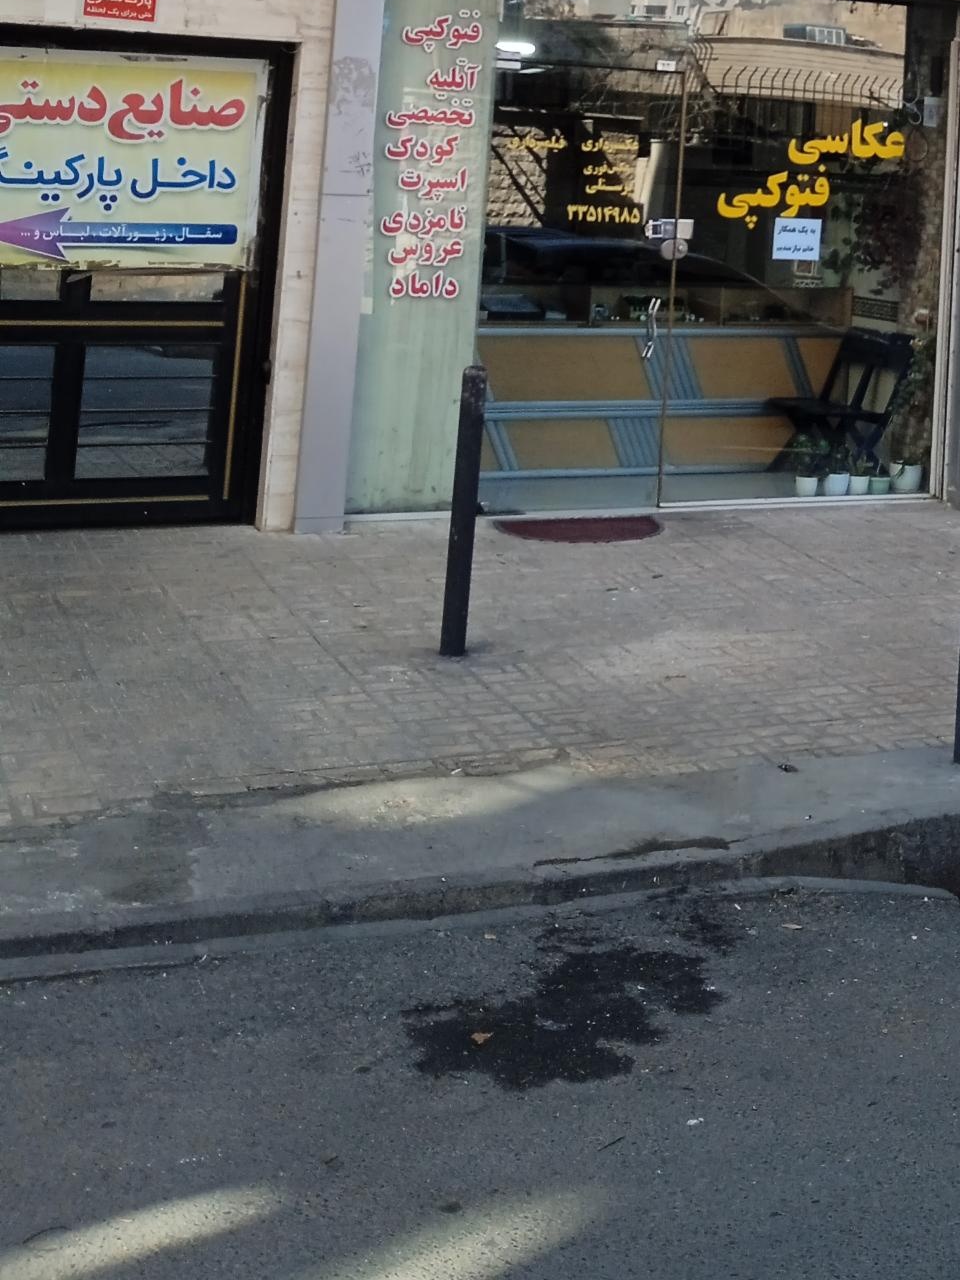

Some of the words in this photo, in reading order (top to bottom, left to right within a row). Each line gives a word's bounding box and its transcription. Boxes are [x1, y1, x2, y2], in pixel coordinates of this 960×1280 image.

[403, 10, 482, 52] فتوکپی
[426, 58, 481, 99] آتلیه
[107, 78, 247, 141] صنایع
[386, 99, 475, 128] تخصصی
[385, 135, 459, 166] کودک
[788, 119, 905, 165] عکاسی
[130, 157, 236, 200] داخل
[400, 168, 468, 201] اسپرت
[717, 164, 831, 230] فتوکپی
[381, 206, 467, 239] نامزدی
[567, 204, 641, 224] ۳۳۵۱۴۹۸۵
[42, 226, 90, 241] لباس
[175, 227, 223, 242] سفال
[388, 239, 464, 267] عروس
[390, 270, 460, 299] داماد
